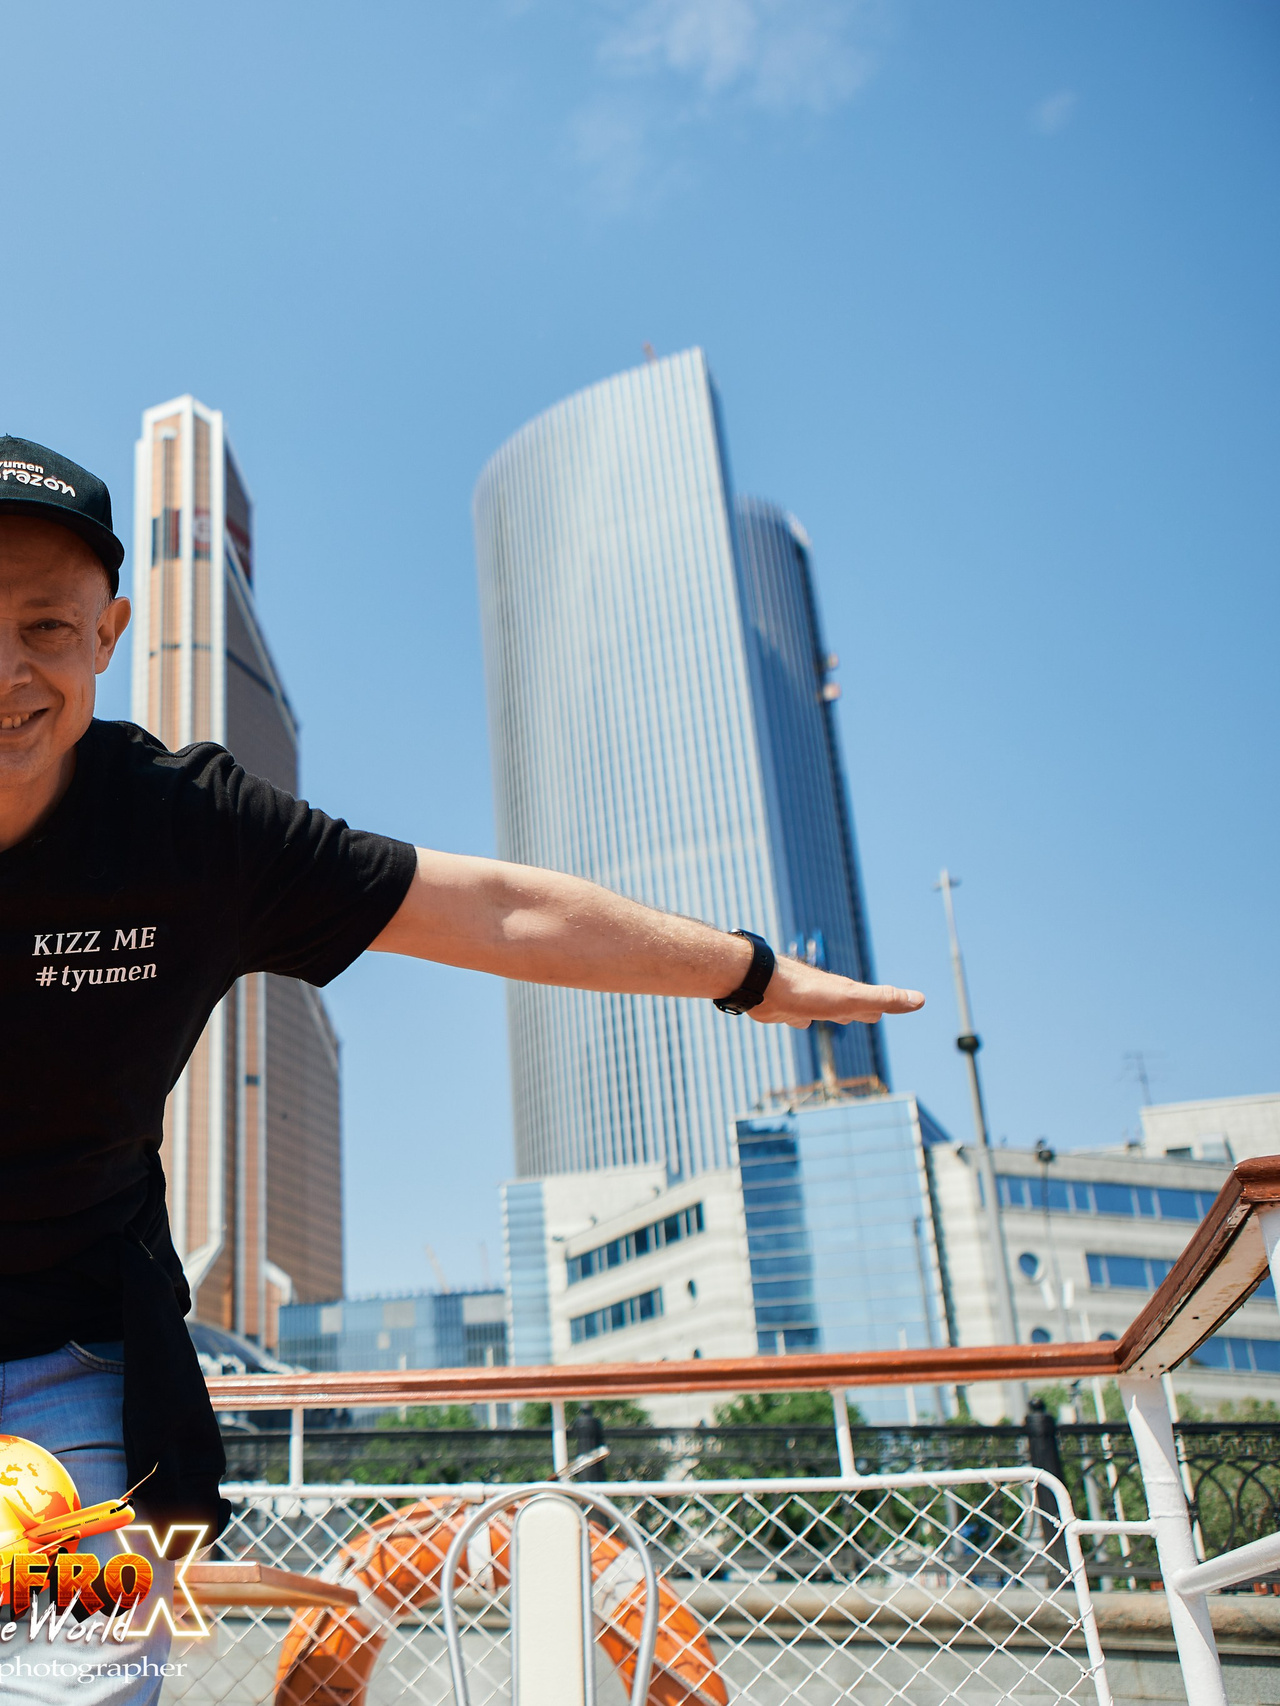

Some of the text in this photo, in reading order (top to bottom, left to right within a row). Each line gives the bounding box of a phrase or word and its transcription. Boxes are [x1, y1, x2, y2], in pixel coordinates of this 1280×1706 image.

[32, 926, 157, 956] KIZZ ME
[35, 961, 157, 992] #tyumen
